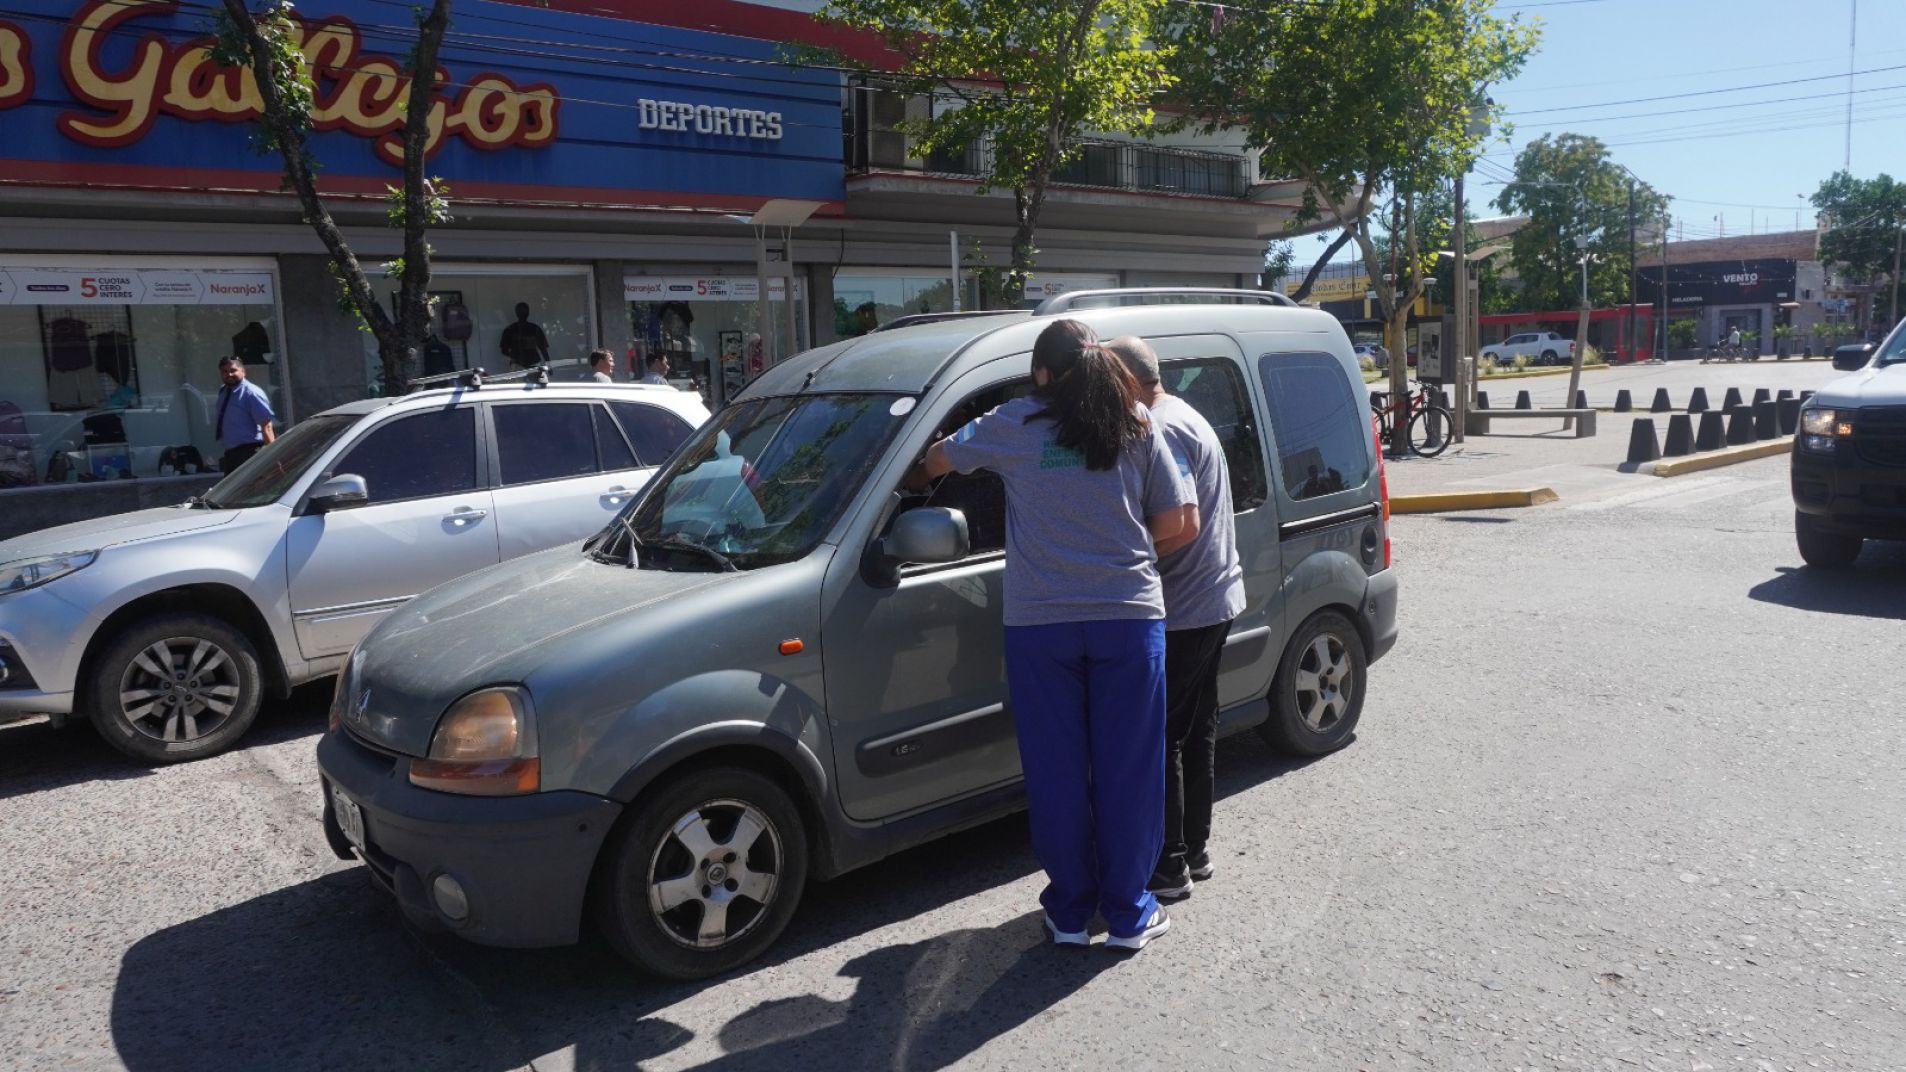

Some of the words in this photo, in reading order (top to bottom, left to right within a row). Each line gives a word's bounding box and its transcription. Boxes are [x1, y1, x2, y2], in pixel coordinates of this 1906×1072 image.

[637, 98, 784, 140] DEPORTES
[1723, 272, 1758, 283] VENTO
[81, 278, 98, 298] 5
[697, 280, 707, 295] 5
